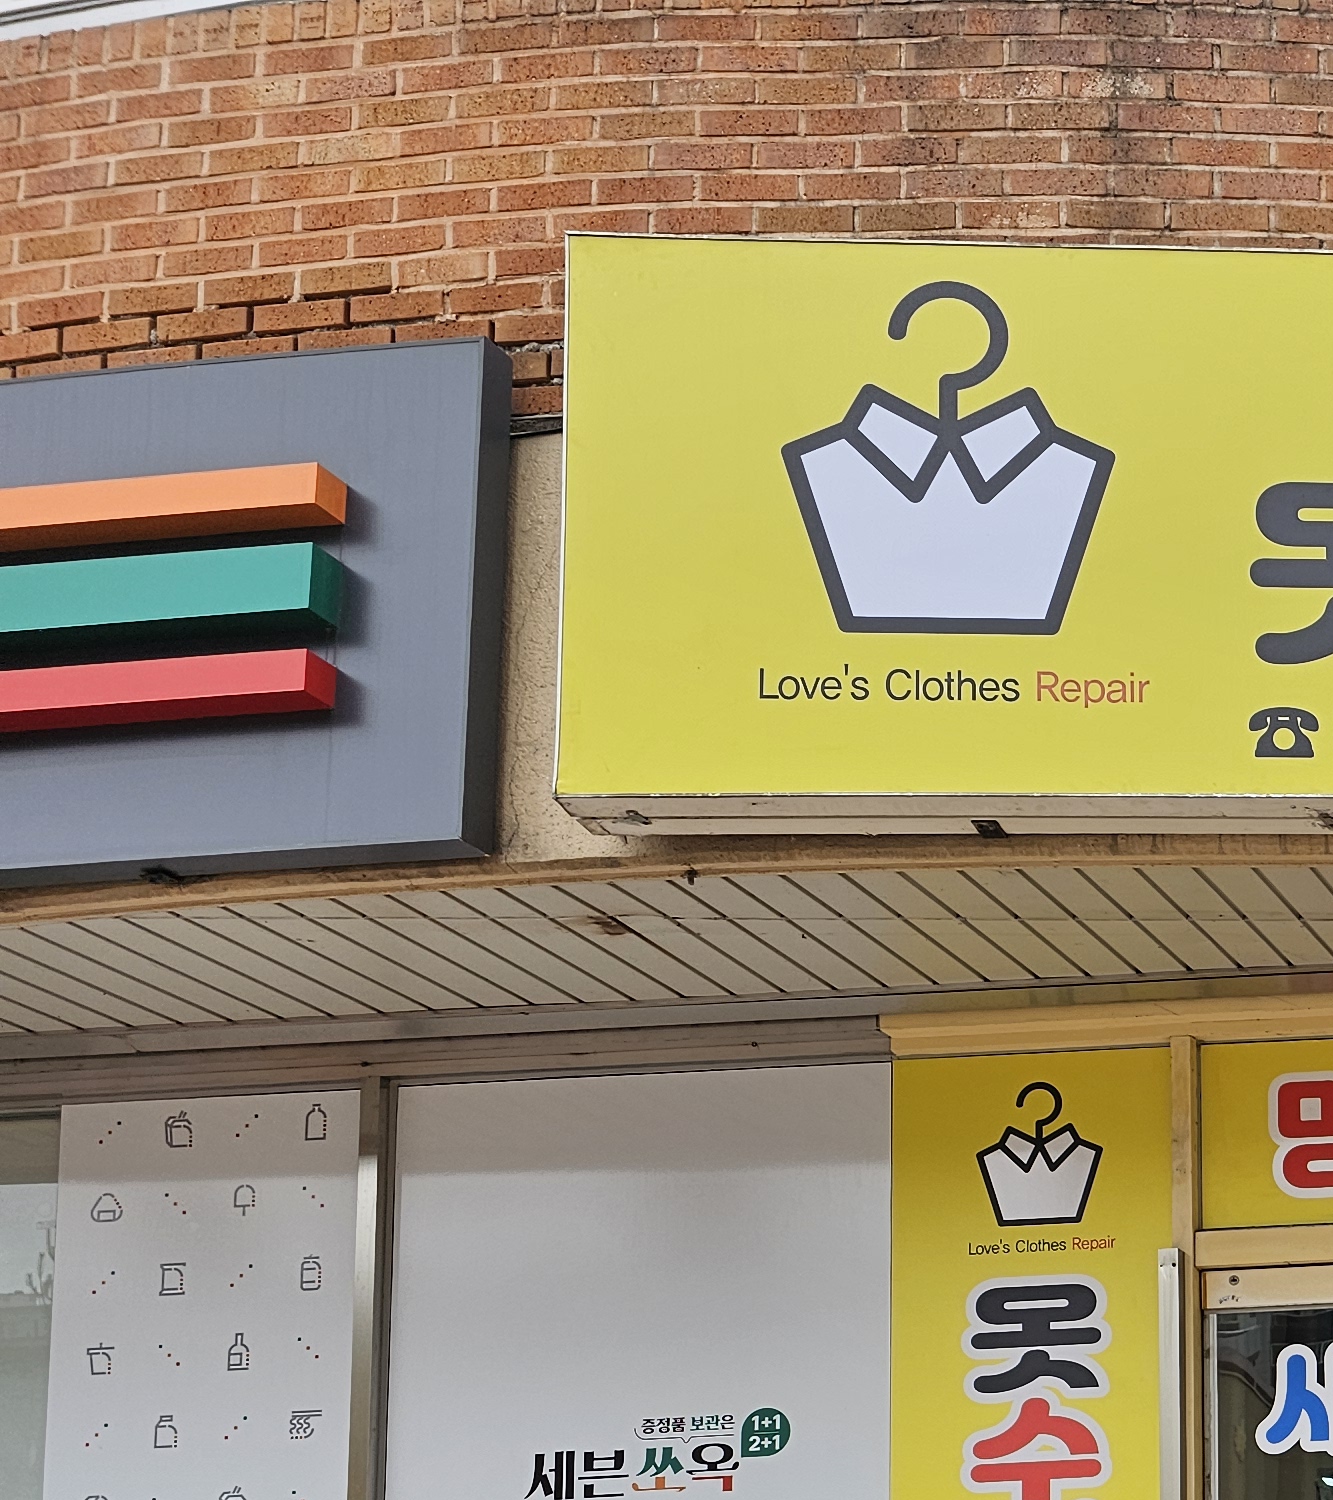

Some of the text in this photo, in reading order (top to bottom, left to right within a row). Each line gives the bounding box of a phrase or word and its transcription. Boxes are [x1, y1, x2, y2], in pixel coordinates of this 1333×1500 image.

[758, 664, 1150, 709] Love's Clothes Repair
[968, 1235, 1116, 1256] Love's Clothes Repair
[640, 1414, 735, 1434] 증정품 보관은
[751, 1414, 781, 1431] 1+1
[748, 1434, 781, 1452] 2+1
